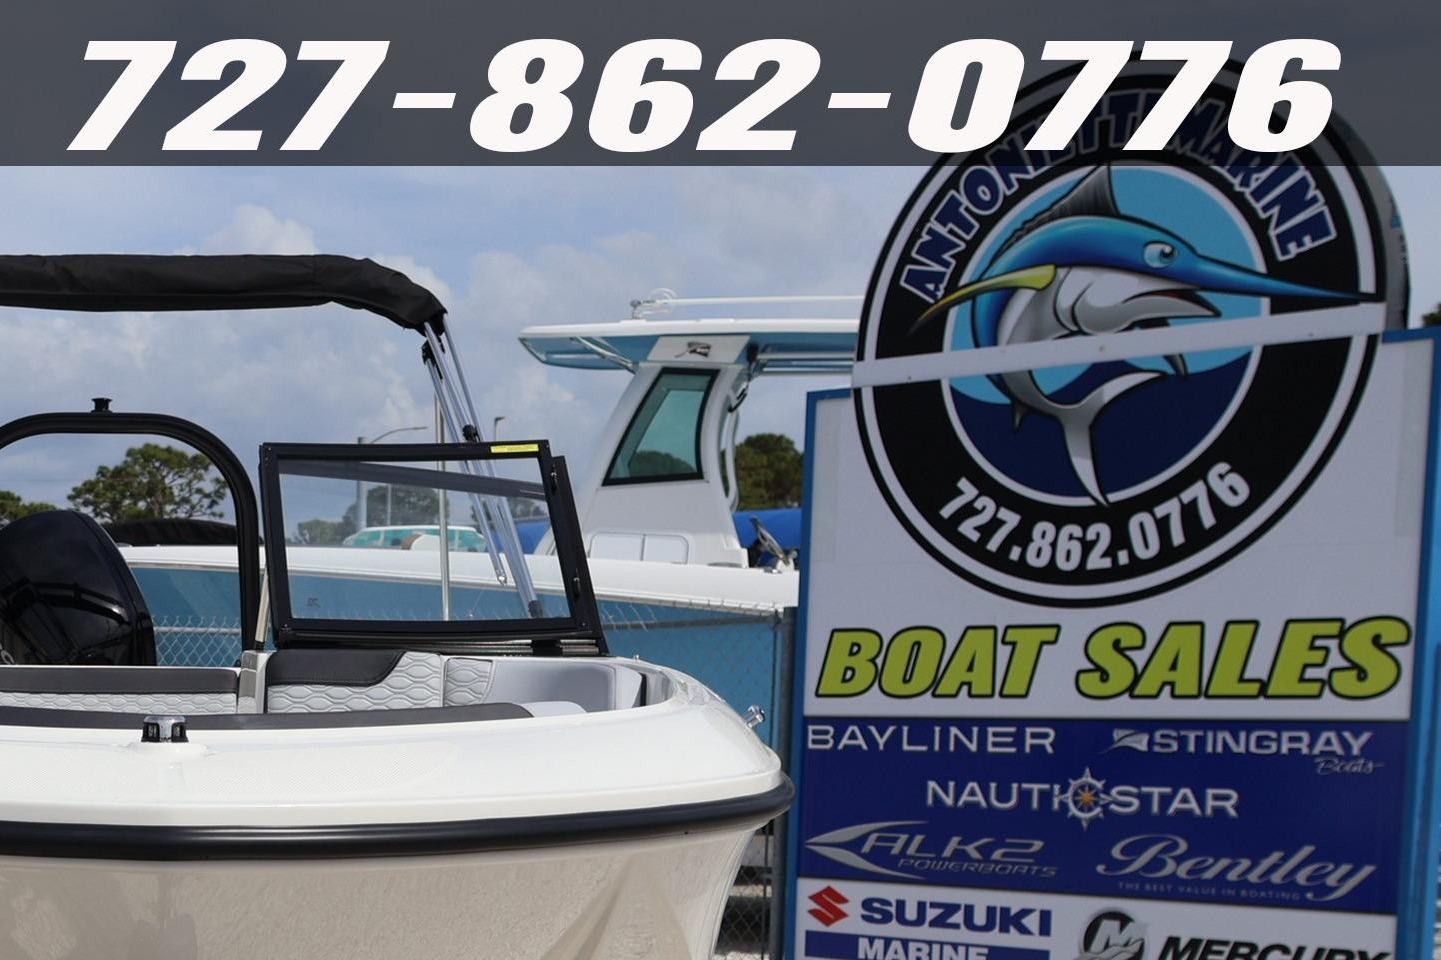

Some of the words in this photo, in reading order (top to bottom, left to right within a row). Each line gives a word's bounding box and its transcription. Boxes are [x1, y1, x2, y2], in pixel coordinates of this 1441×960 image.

[939, 461, 1251, 571] 727.862.0776
[815, 624, 1060, 699] BOAT
[1075, 616, 1412, 700] SALES
[807, 725, 1057, 754] BAYLINER
[1152, 730, 1373, 756] STINGRAY
[1316, 756, 1385, 775] Boats
[898, 858, 1058, 878] POWERBOATS
[1096, 833, 1377, 901] Bentley
[1119, 881, 1140, 892] THE
[1144, 883, 1173, 894] BEST
[1178, 885, 1216, 897] VALUE
[1222, 888, 1236, 898] IN
[1240, 889, 1301, 901] BOATING
[861, 898, 1052, 937] SUZUKI
